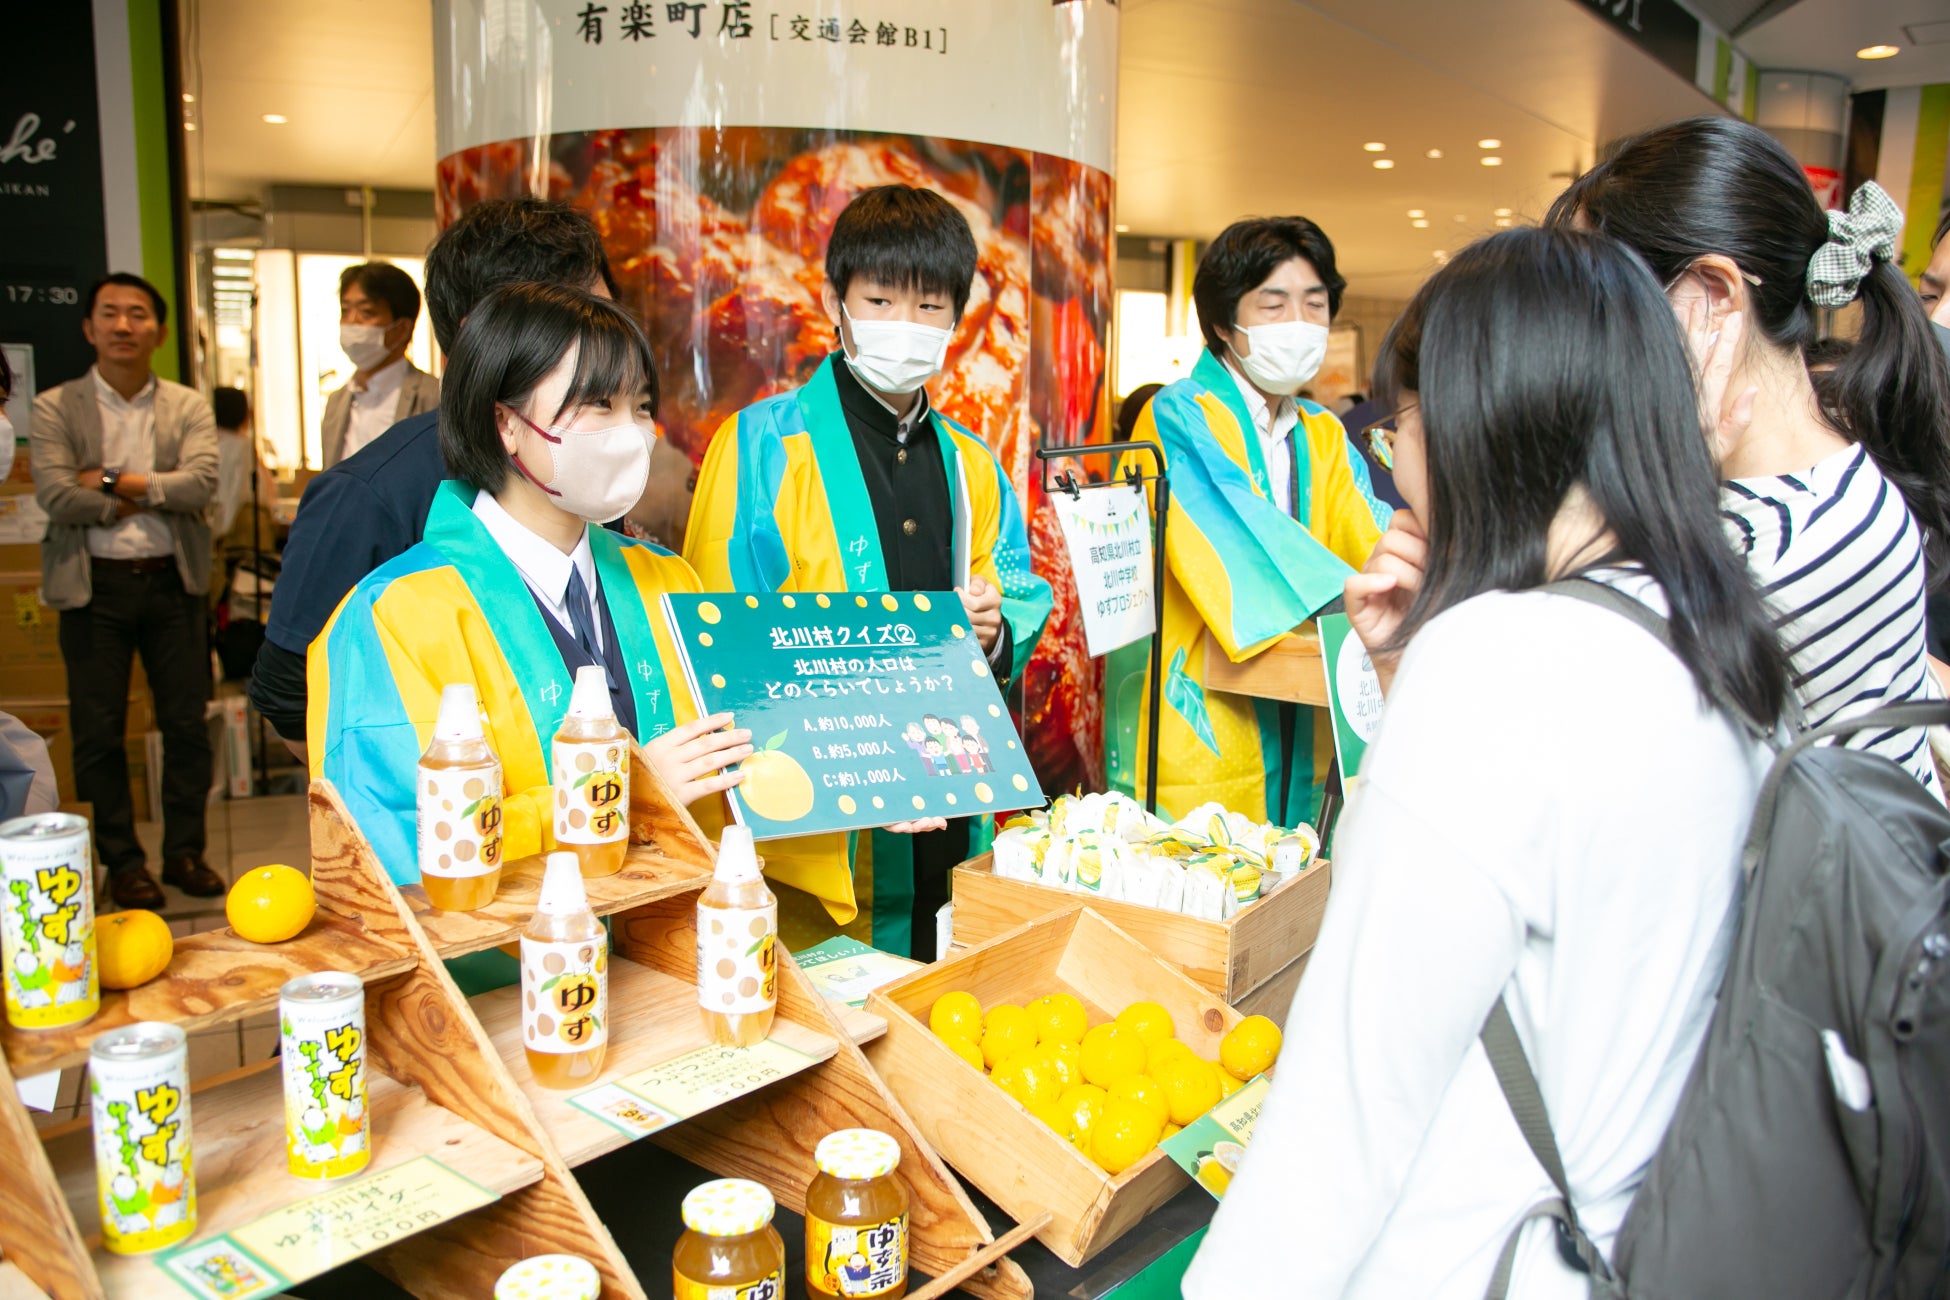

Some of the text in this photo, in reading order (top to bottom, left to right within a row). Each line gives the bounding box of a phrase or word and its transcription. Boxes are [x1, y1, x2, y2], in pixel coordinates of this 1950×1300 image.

[576, 0, 754, 44] 有楽町店
[850, 535, 879, 592] ゆず
[1089, 539, 1142, 566] 高知県北川村立
[1103, 565, 1139, 590] 北川中学校
[1096, 588, 1150, 618] ゆずプロジェクト
[769, 624, 917, 646] 北川村クイズ②
[793, 656, 917, 676] 北川村の人口は
[480, 804, 502, 863] ゆず
[592, 780, 621, 834] ゆず
[9, 880, 41, 952] サイダー
[36, 863, 82, 946] ゆず
[561, 982, 596, 1042] ゆず
[299, 1040, 329, 1109] サイダー
[324, 1021, 362, 1101] ゆず
[107, 1100, 139, 1176] サイダー
[135, 1080, 181, 1168] ゆず
[304, 1185, 385, 1227] 北川村
[869, 1226, 895, 1292] ゆず茶
